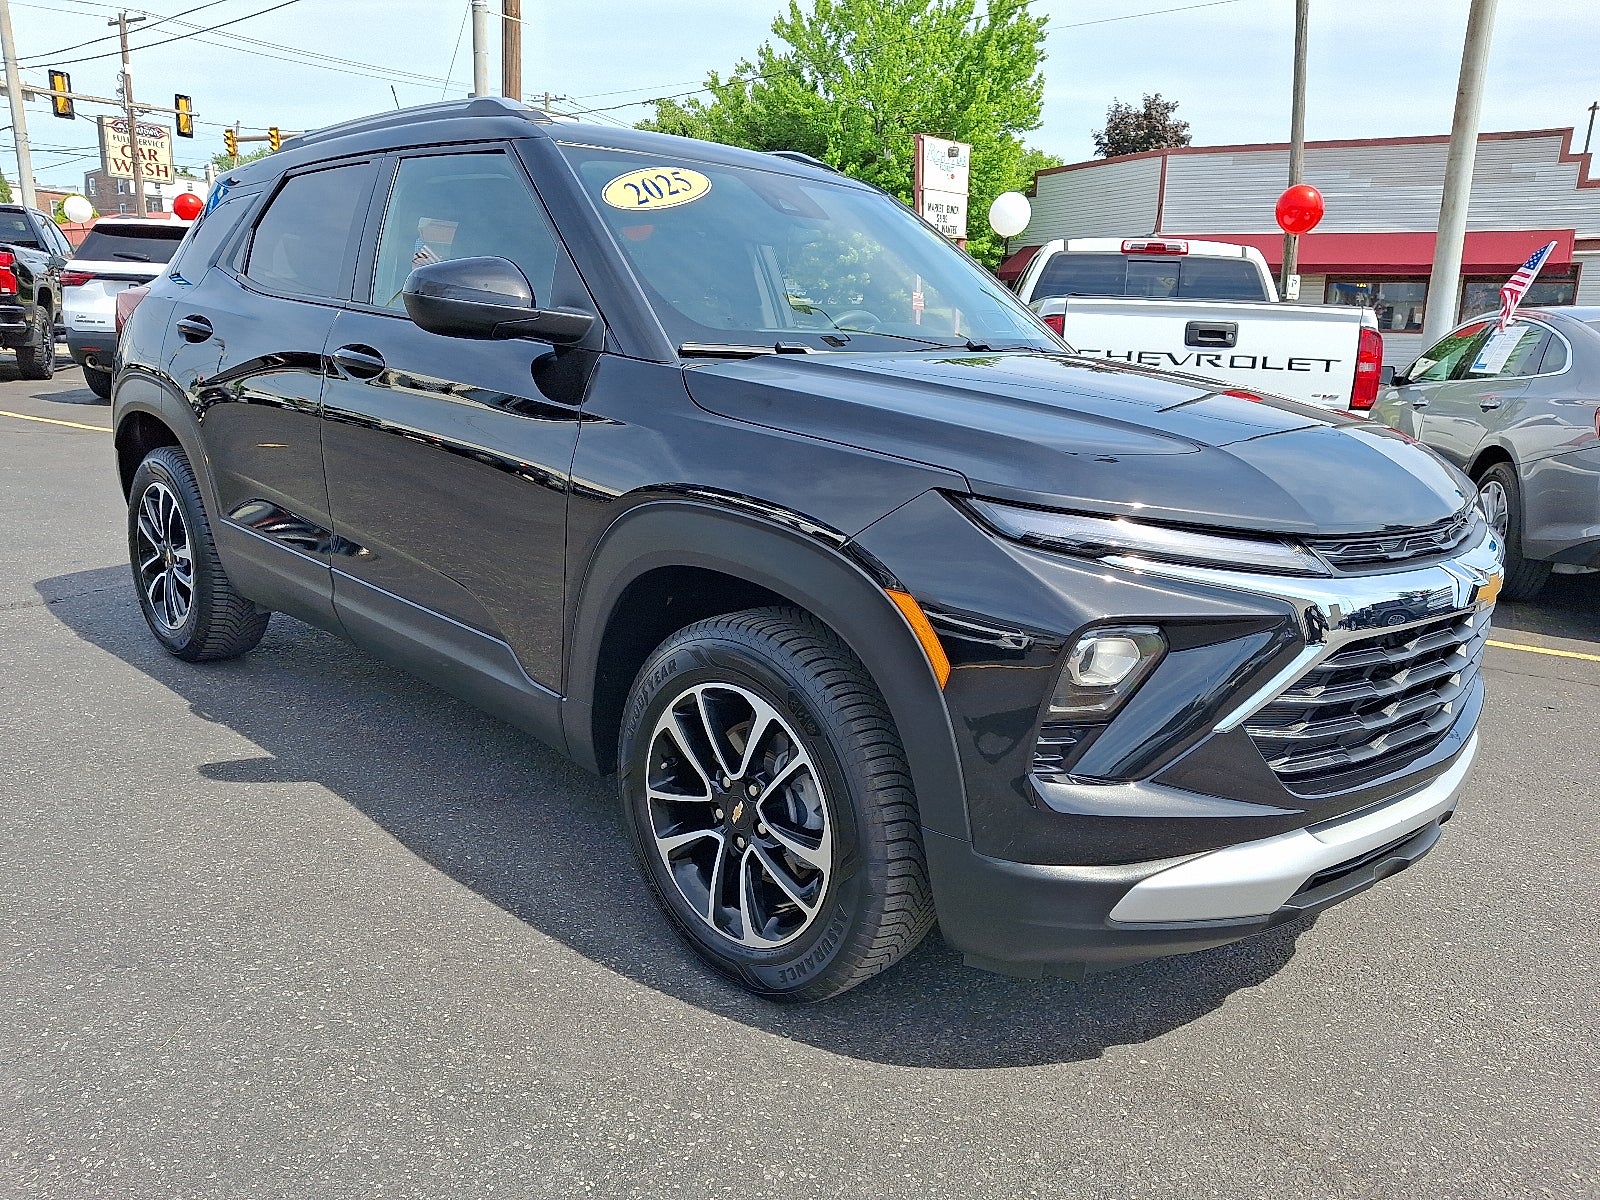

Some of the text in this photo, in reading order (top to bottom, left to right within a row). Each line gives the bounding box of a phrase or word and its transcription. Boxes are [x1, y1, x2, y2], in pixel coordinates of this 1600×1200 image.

[120, 144, 159, 162] CAR
[136, 138, 165, 149] ERVICE
[112, 158, 169, 178] WSH
[623, 171, 692, 206] 2025
[626, 658, 678, 738] GOODYEAR
[778, 903, 849, 984] ASSURANCE
